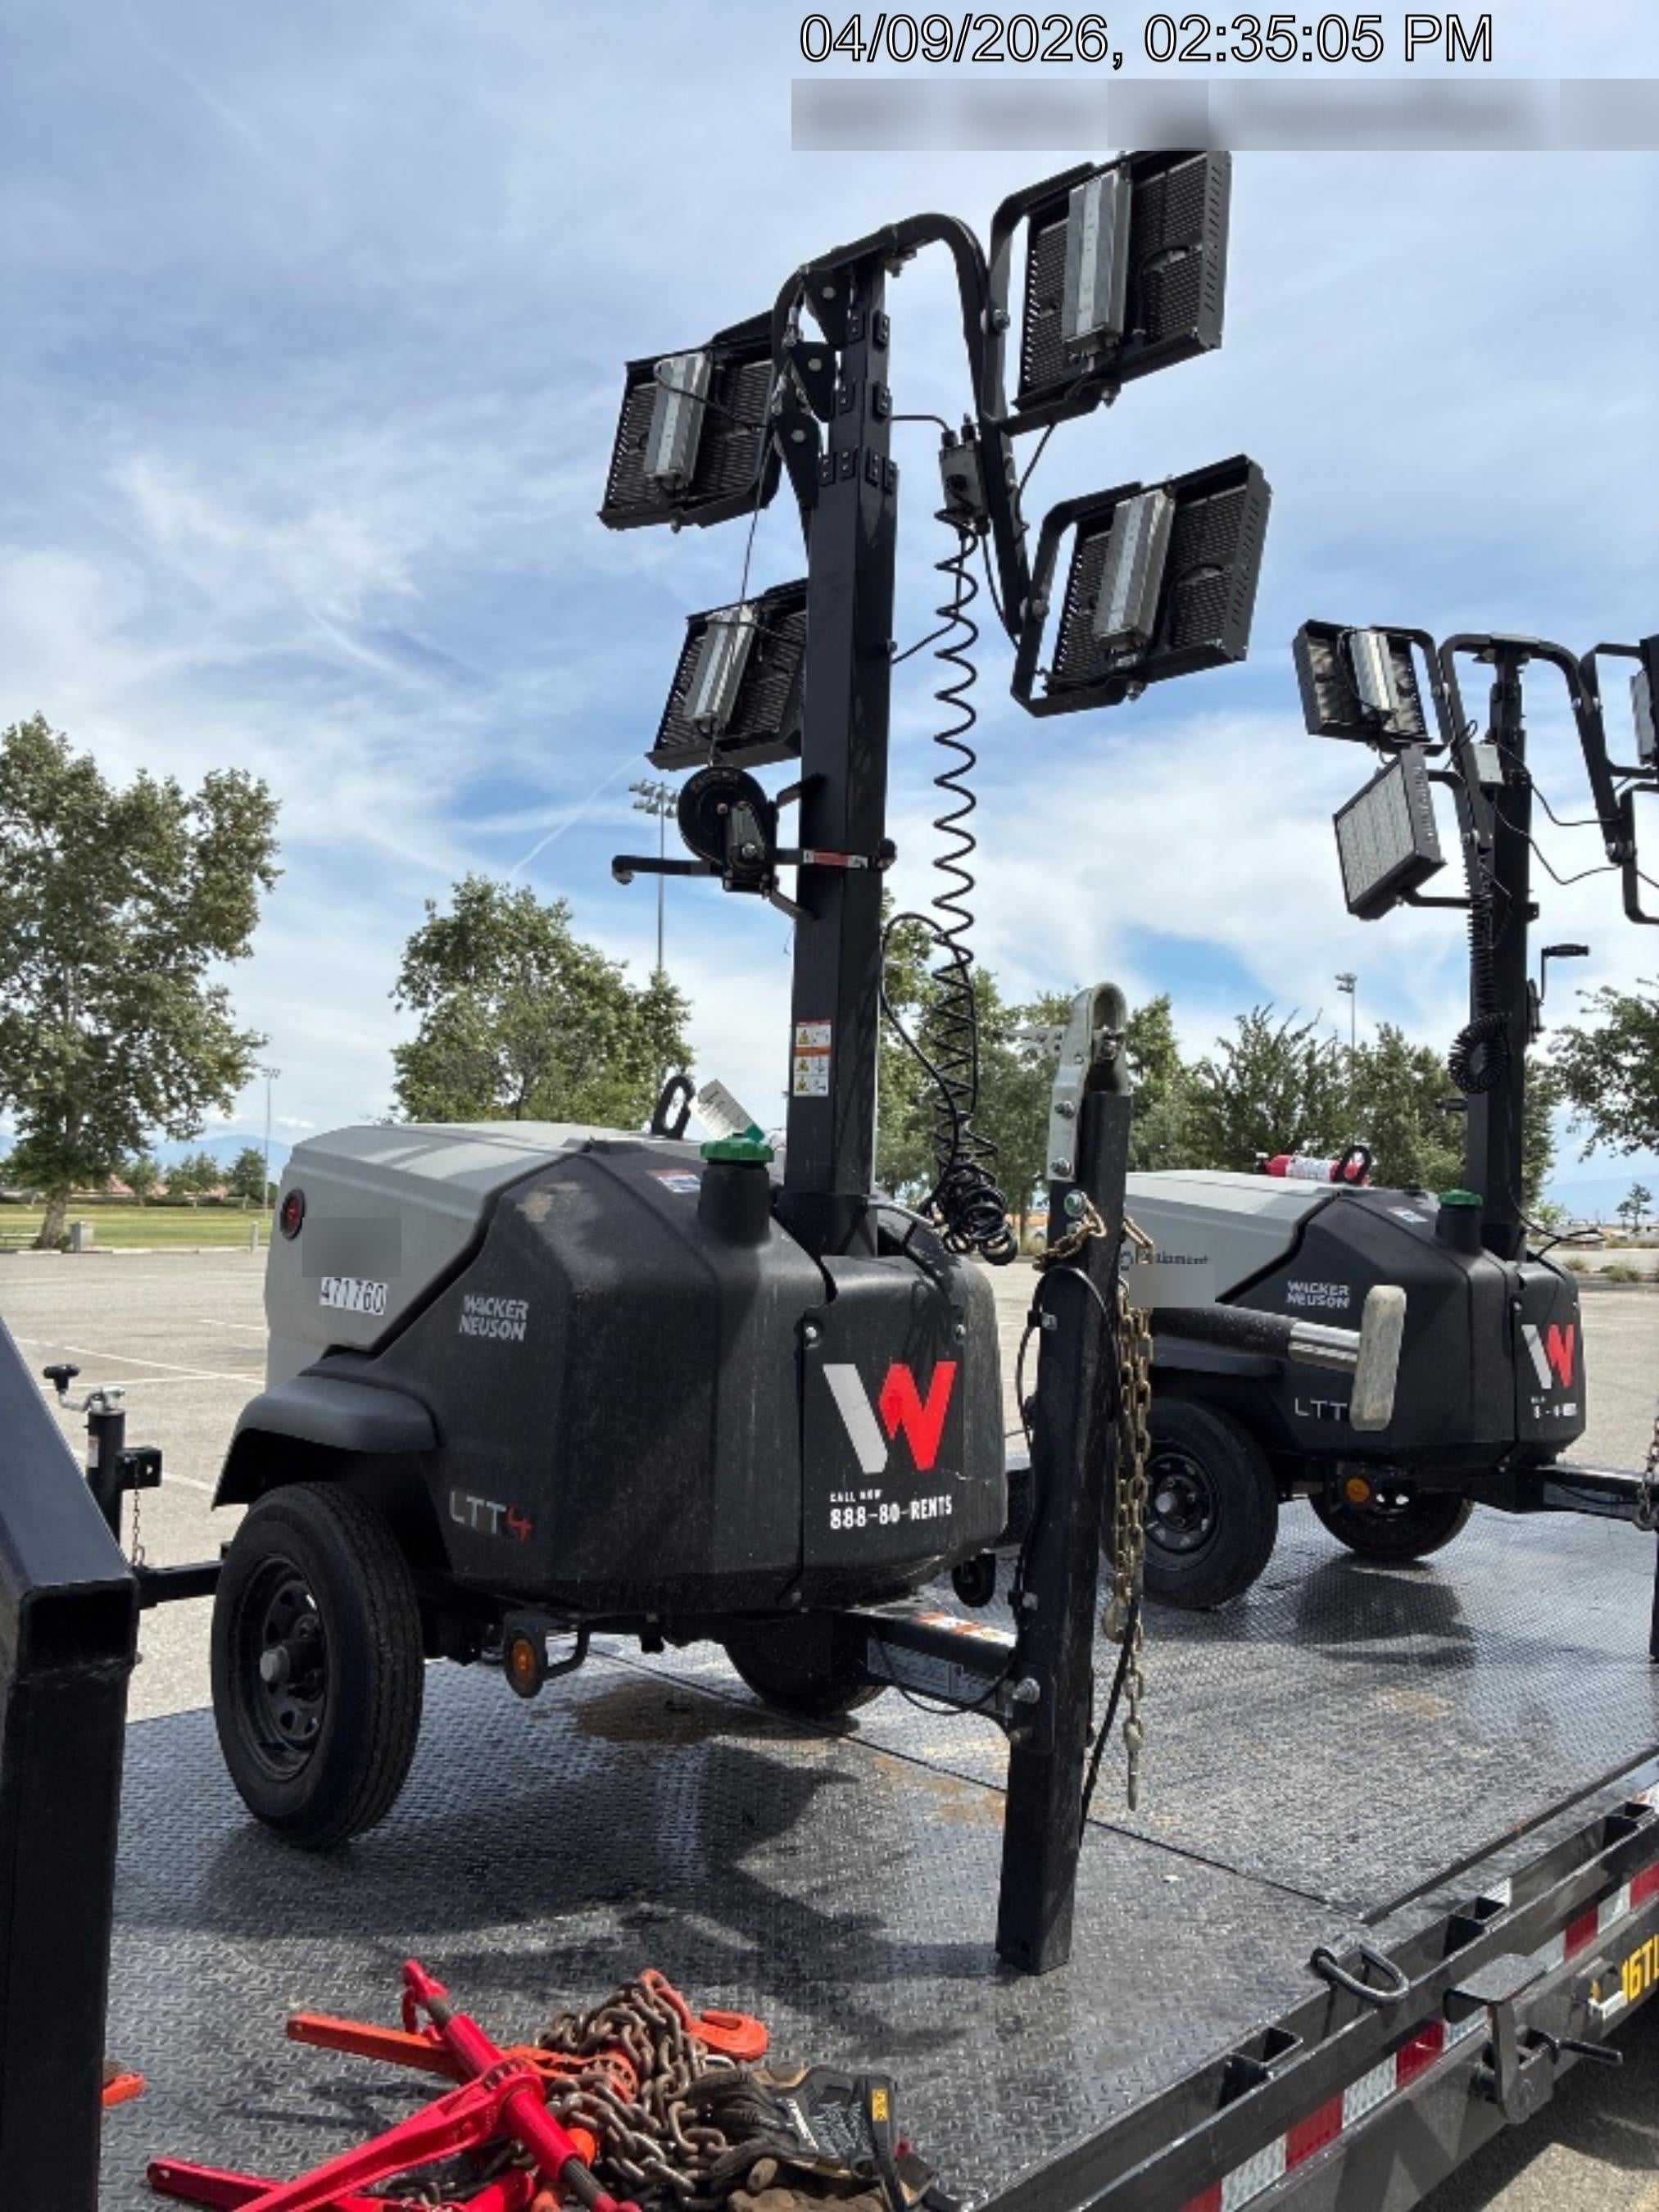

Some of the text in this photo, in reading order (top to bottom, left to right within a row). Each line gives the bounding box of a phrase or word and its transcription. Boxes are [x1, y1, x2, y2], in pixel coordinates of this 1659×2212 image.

[321, 1277, 386, 1313] 471760
[1285, 1293, 1350, 1308] NEUSON
[1286, 1280, 1349, 1295] WACKER
[463, 1294, 529, 1321] WACKER
[459, 1314, 527, 1340] NEUSON
[1294, 1398, 1348, 1421] LTT
[449, 1491, 533, 1543] LTT4
[830, 1494, 953, 1530] 888-80-RENTS
